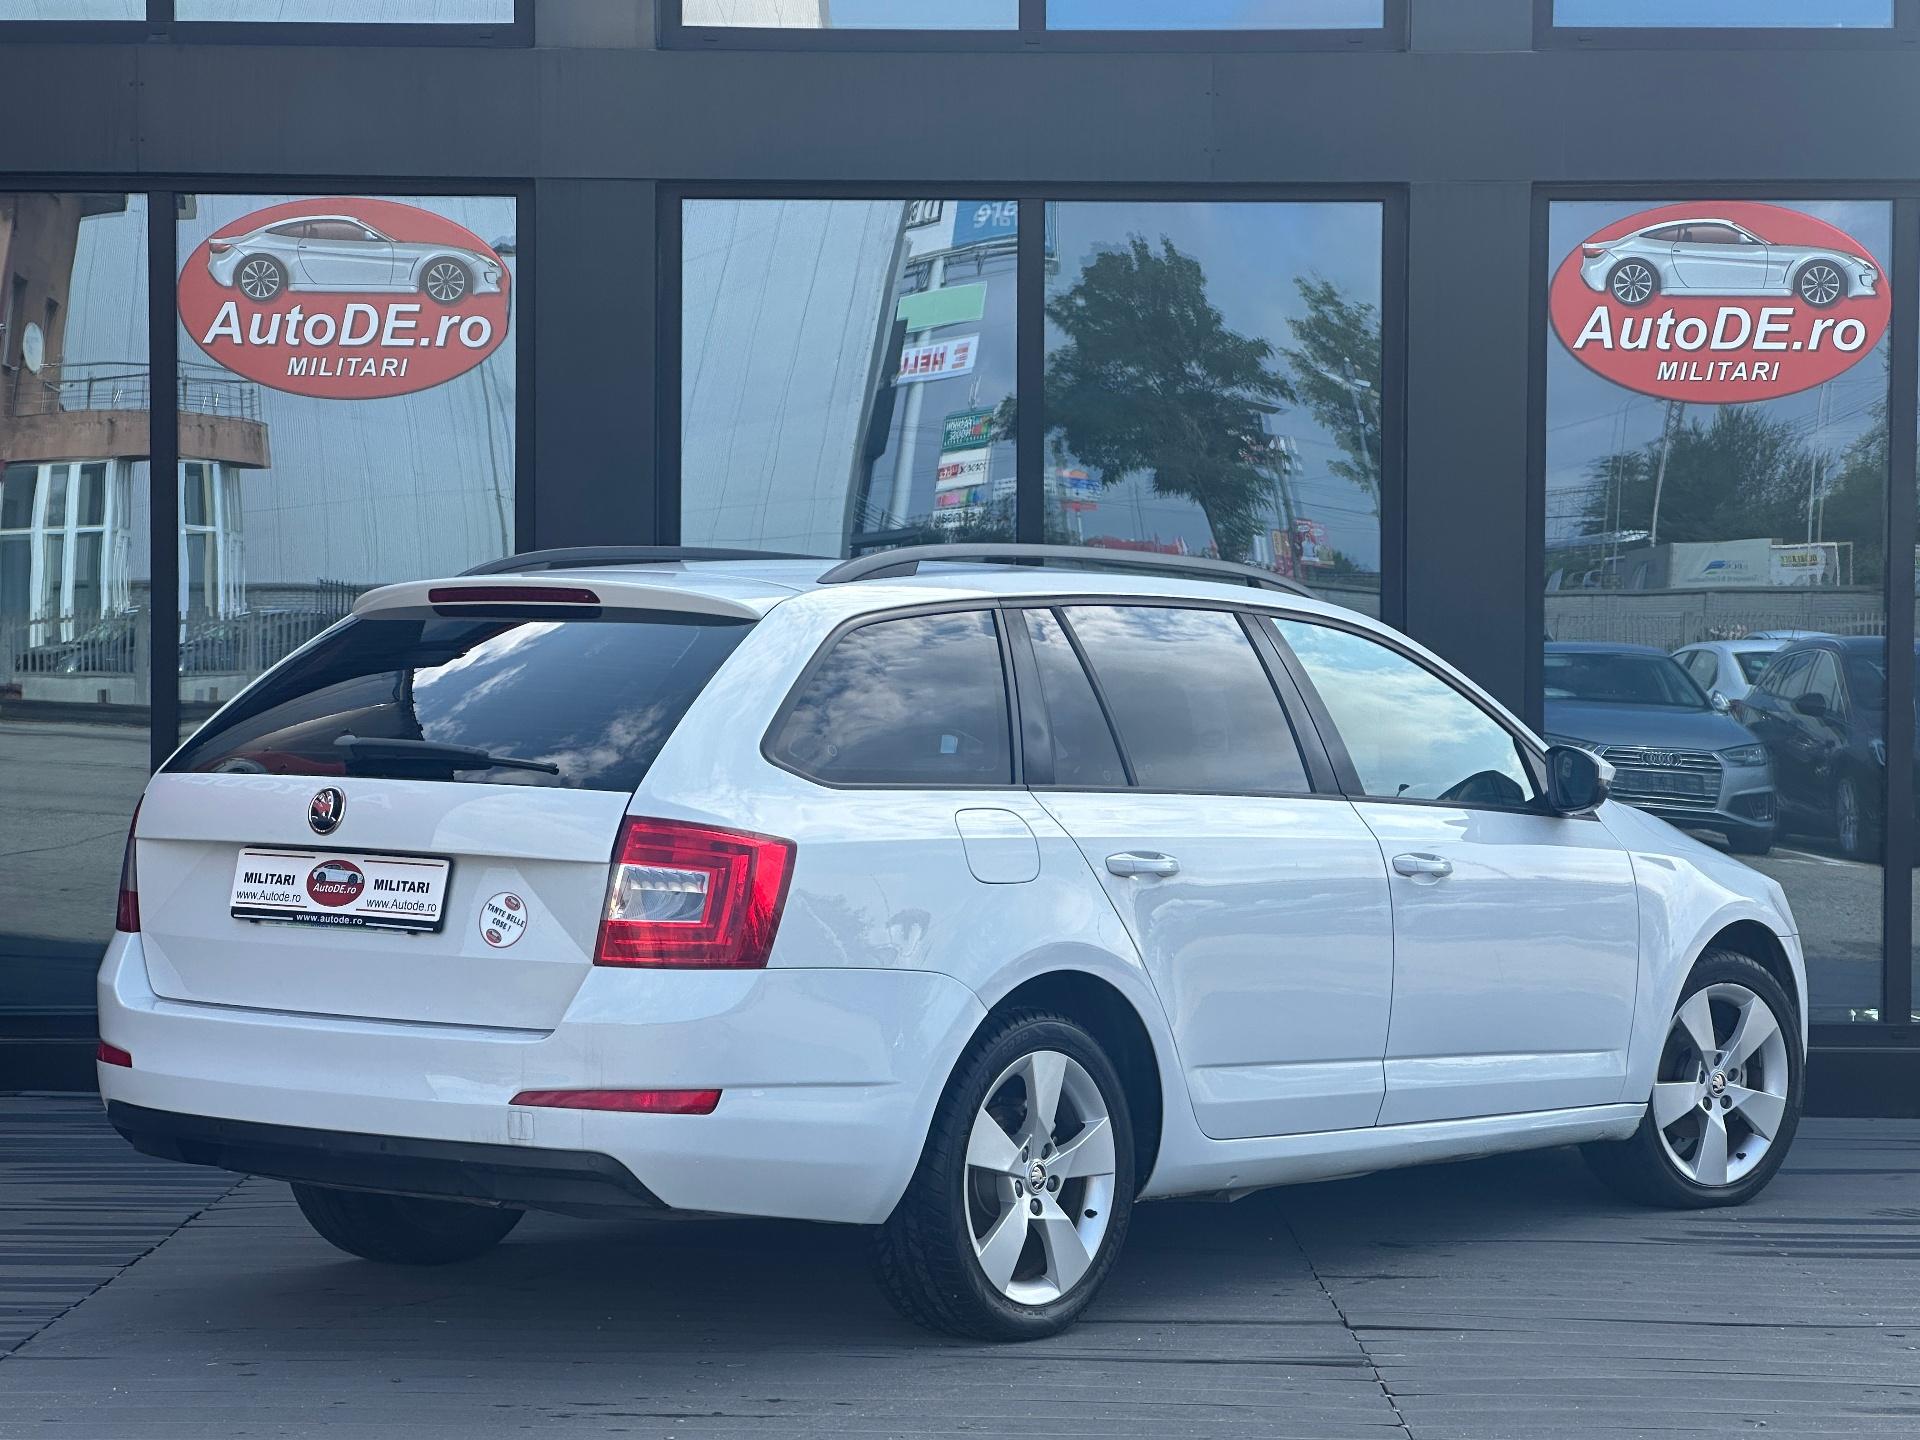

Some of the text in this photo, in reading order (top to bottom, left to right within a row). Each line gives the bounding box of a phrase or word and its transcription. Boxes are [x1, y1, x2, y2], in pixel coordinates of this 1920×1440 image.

[203, 301, 492, 348] AutoDE.ro
[1572, 306, 1867, 351] AutoDE.ro
[286, 357, 408, 377] MILITARI
[1656, 361, 1780, 382] MILITARI
[243, 871, 296, 886] MILITARI
[373, 878, 431, 894] MILITARI
[236, 889, 301, 903] www.Autode.ro
[312, 882, 357, 895] AutoDE.ro
[366, 898, 437, 913] www.Autode.ro
[296, 914, 363, 925] www.autode.ro
[487, 902, 526, 928] TANTE BELLE
[491, 916, 508, 930] COSE
